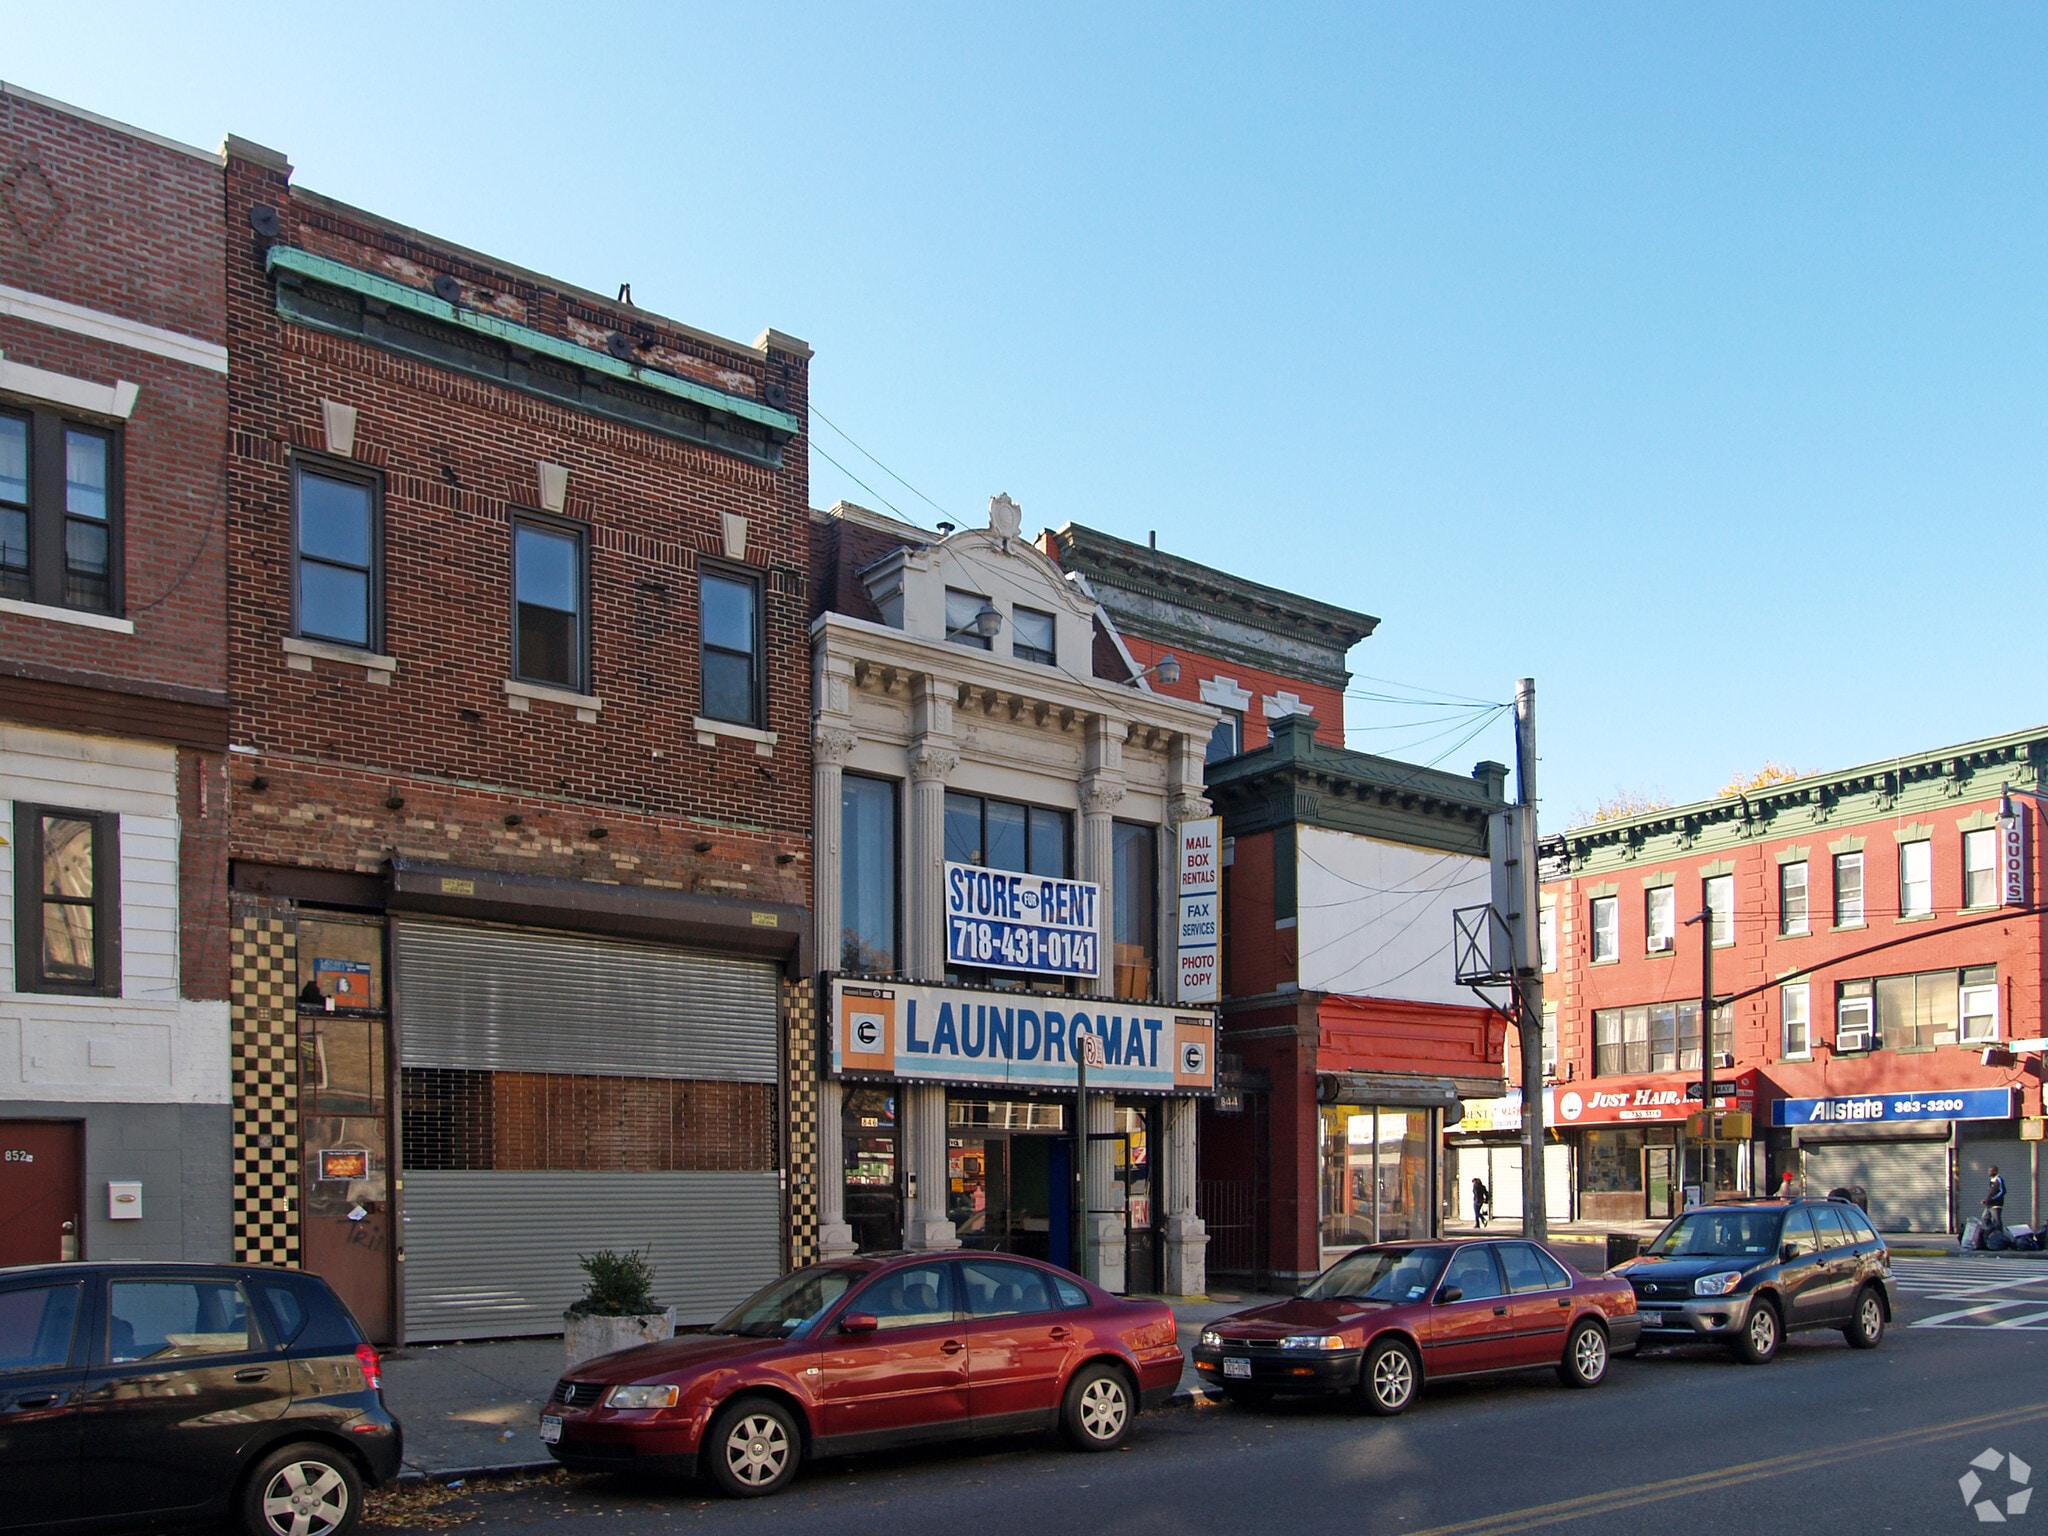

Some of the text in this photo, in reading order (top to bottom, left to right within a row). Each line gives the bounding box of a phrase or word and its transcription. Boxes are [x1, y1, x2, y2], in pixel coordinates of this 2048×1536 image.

[1185, 838, 1212, 850] MAIL
[1187, 853, 1209, 868] BOX
[2007, 817, 2020, 897] IQUORS
[1182, 870, 1215, 885] RENTALS
[950, 867, 1097, 928] STORE FOR RENT
[1187, 904, 1210, 918] FAX
[1182, 921, 1215, 937] SERVICES
[953, 919, 1094, 970] 718-431-0141
[1182, 955, 1215, 969] PHOTO
[1184, 973, 1212, 987] COPY
[906, 999, 1162, 1067] LAUNDROMAT
[1221, 1097, 1238, 1107] 844
[1587, 1091, 1630, 1109] JUST
[1633, 1089, 1680, 1107] HAIR,
[1809, 1098, 1964, 1121] Allstate 363-3200
[5, 1150, 26, 1161] 852
